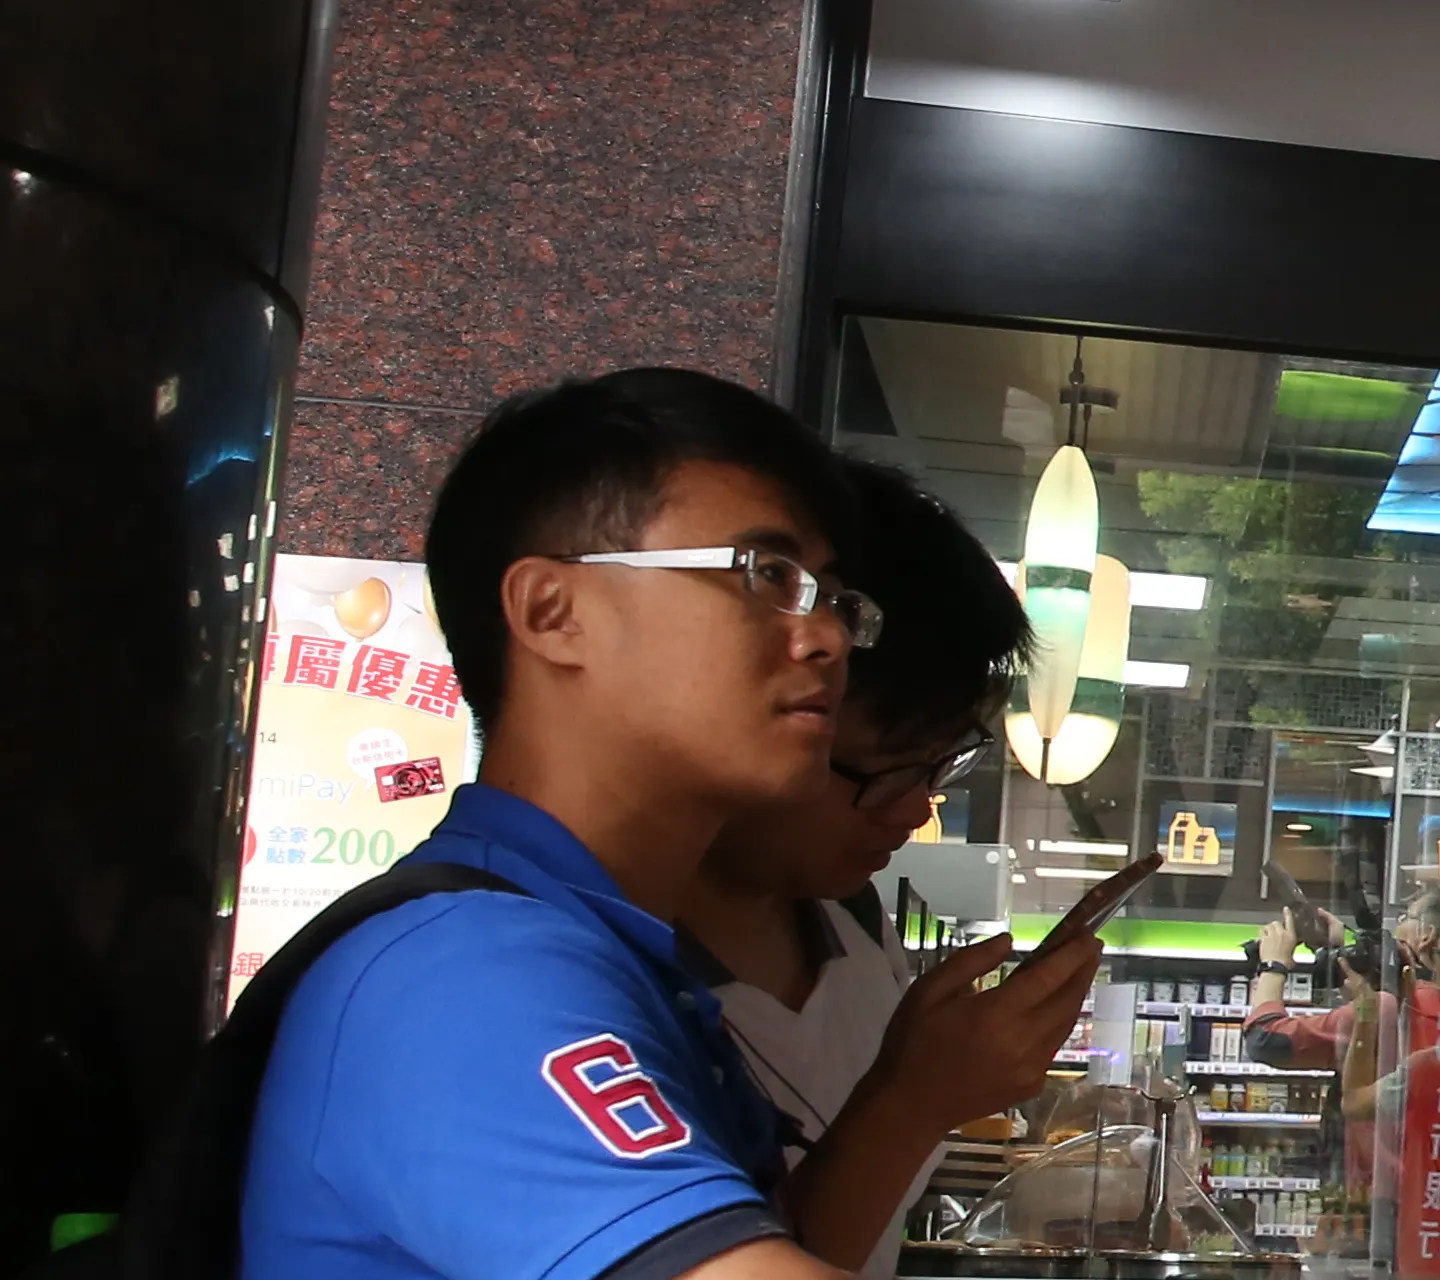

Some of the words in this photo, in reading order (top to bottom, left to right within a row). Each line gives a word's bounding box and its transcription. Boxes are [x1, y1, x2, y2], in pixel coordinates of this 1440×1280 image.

[268, 825, 309, 844] 全家
[311, 826, 395, 867] 200
[266, 846, 307, 865] 點數
[541, 1032, 692, 1160] 6
